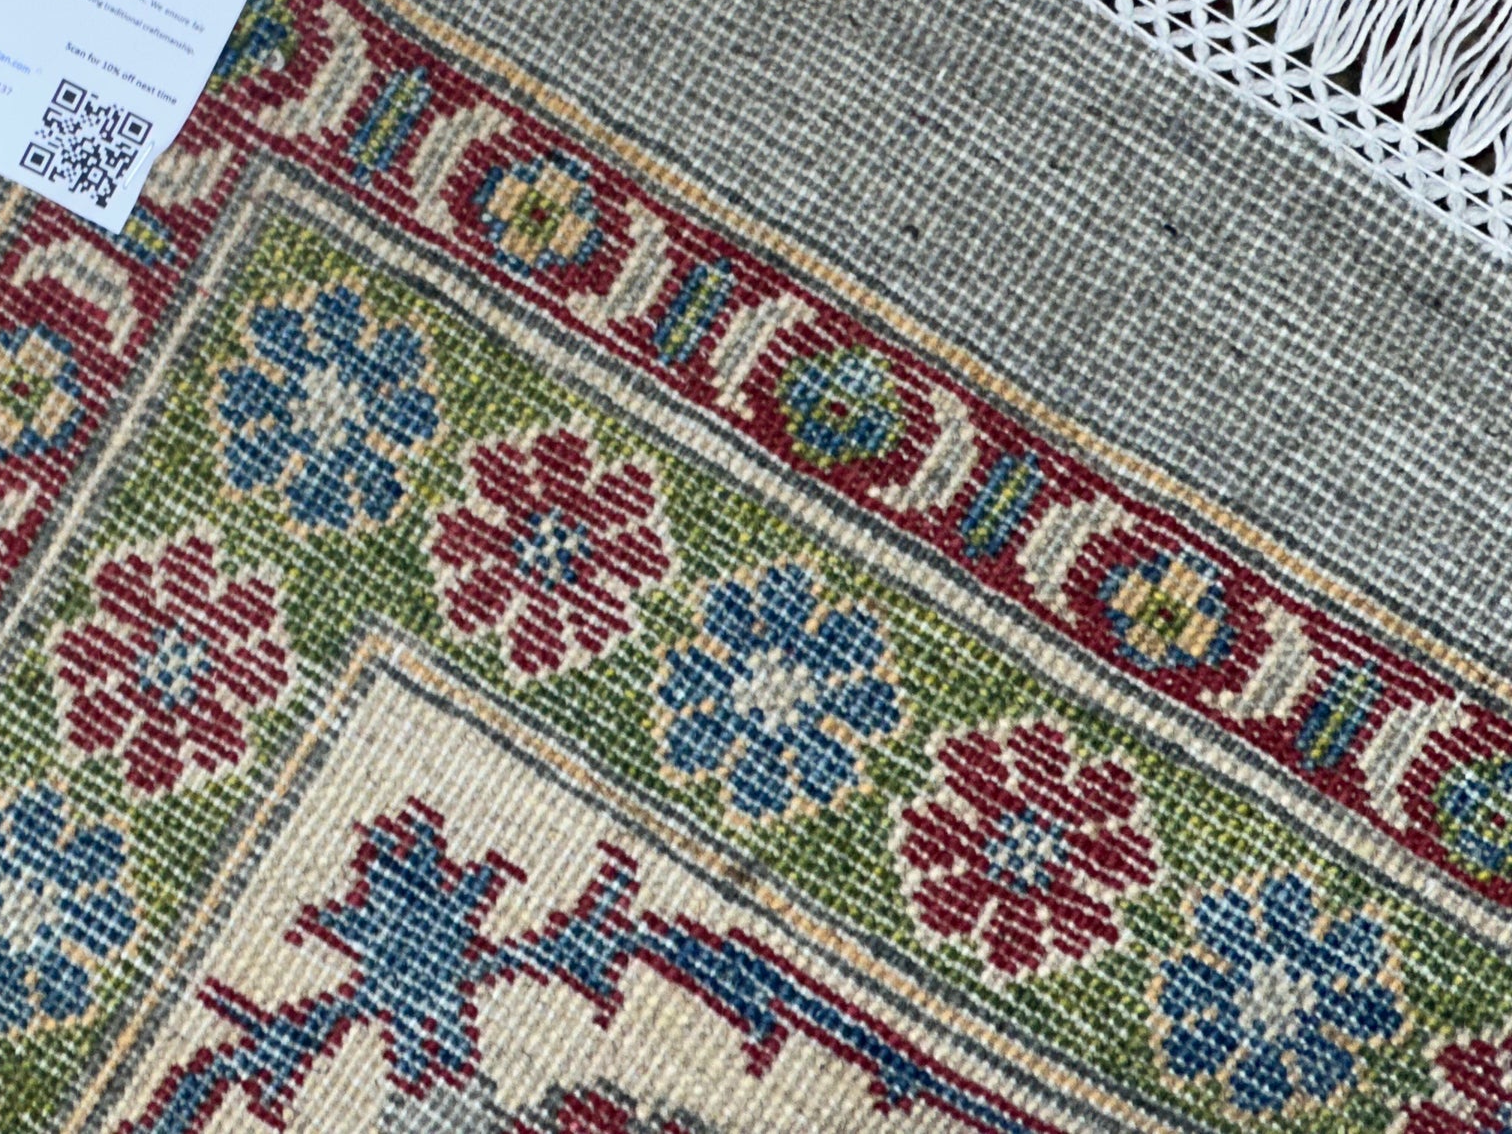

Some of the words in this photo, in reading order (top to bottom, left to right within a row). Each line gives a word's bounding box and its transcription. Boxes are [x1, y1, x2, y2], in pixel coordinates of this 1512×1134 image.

[163, 7, 190, 26] ensure
[190, 19, 205, 33] fair
[64, 41, 86, 58] Scan
[86, 51, 101, 65] for
[101, 60, 121, 76] 10%
[120, 70, 136, 84] off
[134, 79, 155, 95] next
[156, 88, 177, 105] time
